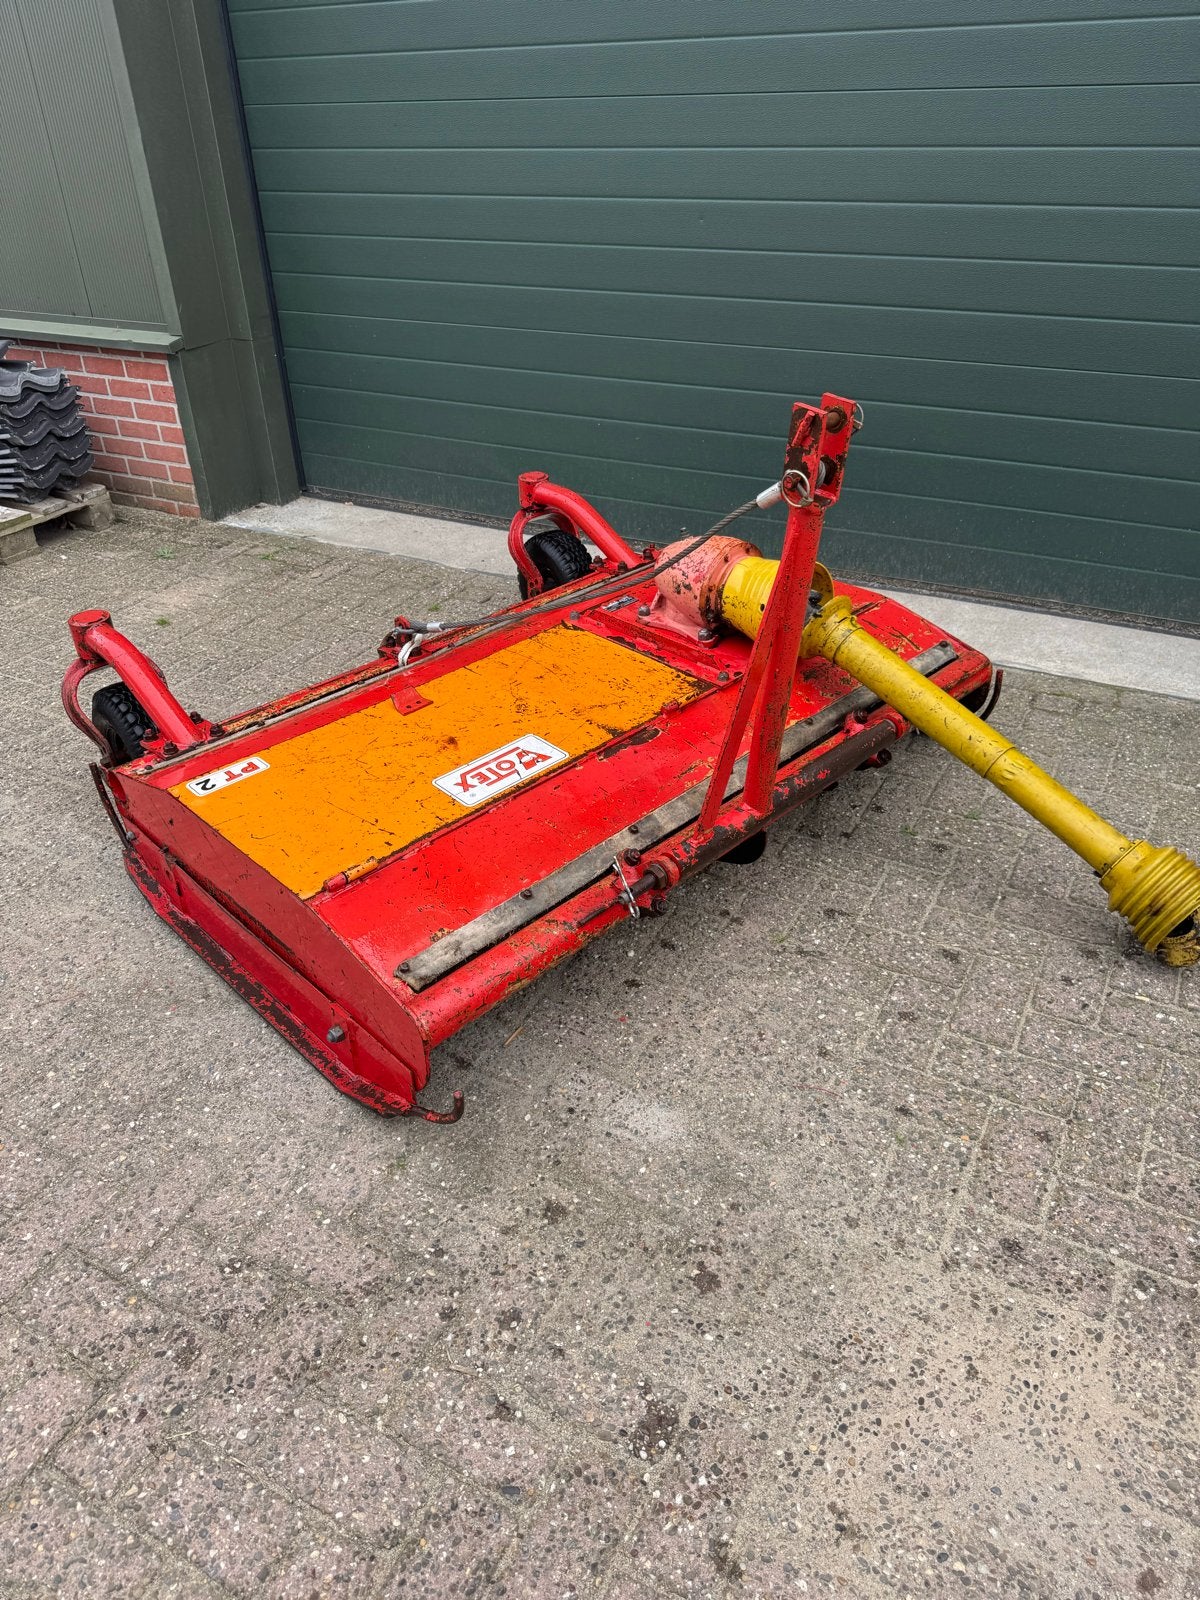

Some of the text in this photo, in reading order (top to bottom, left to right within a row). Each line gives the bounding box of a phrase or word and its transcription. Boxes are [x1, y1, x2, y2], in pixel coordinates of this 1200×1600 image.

[195, 761, 260, 791] PT 2
[453, 746, 553, 793] VOTEX
